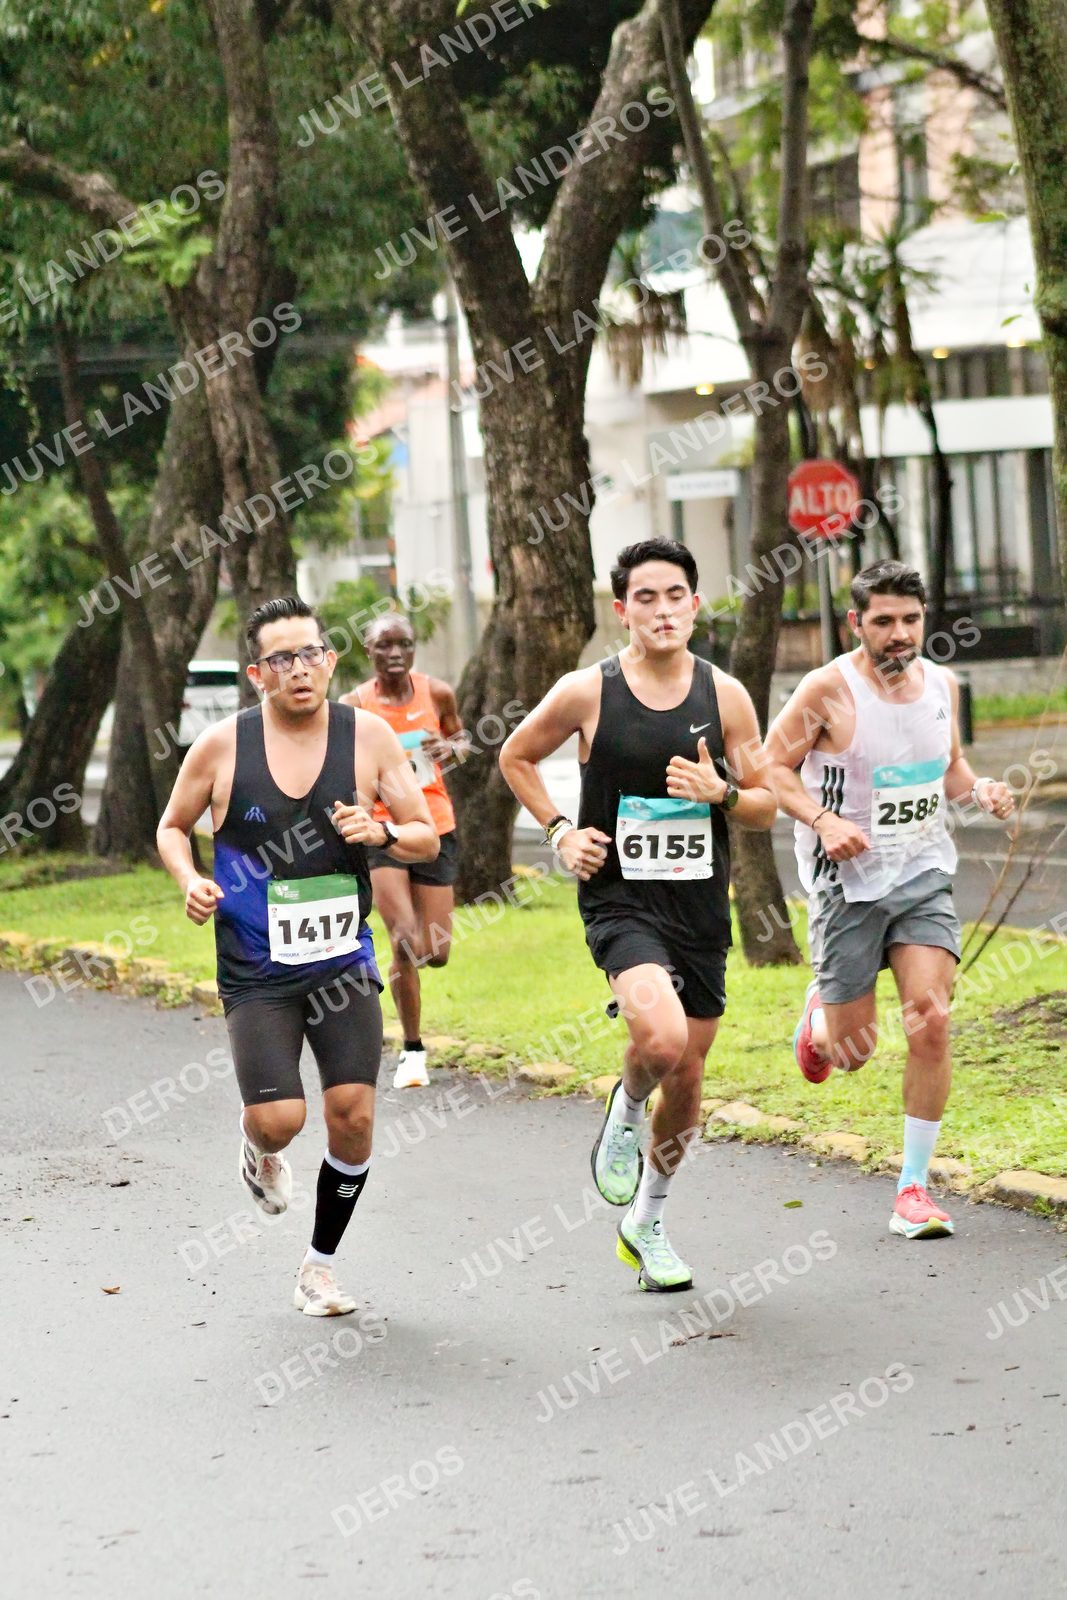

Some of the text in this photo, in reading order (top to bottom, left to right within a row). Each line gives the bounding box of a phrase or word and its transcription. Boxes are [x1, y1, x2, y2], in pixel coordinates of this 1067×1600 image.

[789, 482, 853, 515] ALTO
[877, 793, 939, 826] 2588
[623, 834, 705, 860] 6155
[278, 911, 353, 944] 1417
